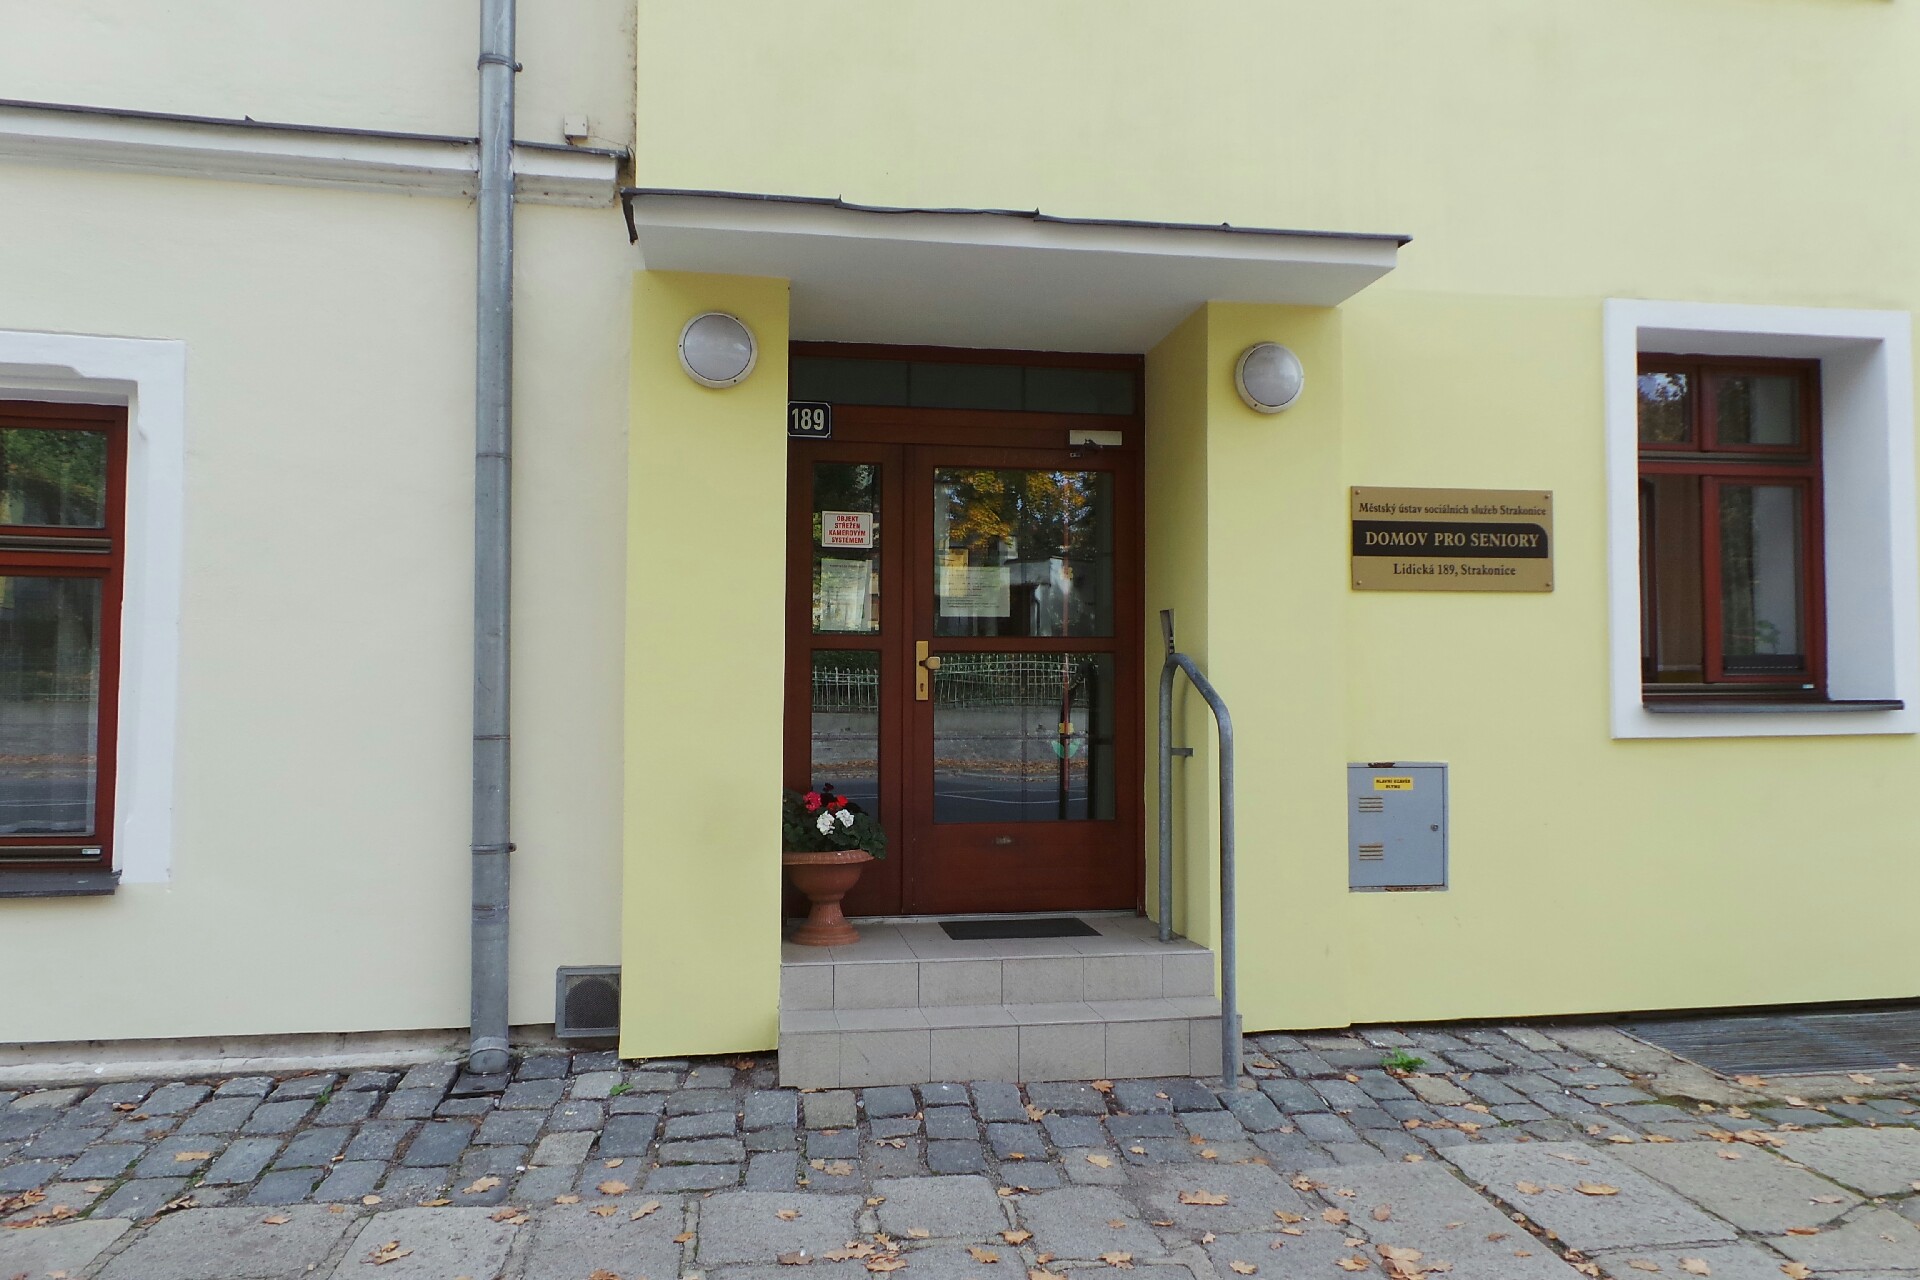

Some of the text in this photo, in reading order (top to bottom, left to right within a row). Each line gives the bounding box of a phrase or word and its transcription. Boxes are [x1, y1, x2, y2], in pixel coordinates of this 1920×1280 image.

[792, 408, 824, 430] 189
[1359, 502, 1546, 516] Městský ústav sociálních služeb Strakonice
[1365, 531, 1540, 548] DOMOV PRO SENIORY
[1393, 563, 1516, 577] Lidická 189, Strakonice
